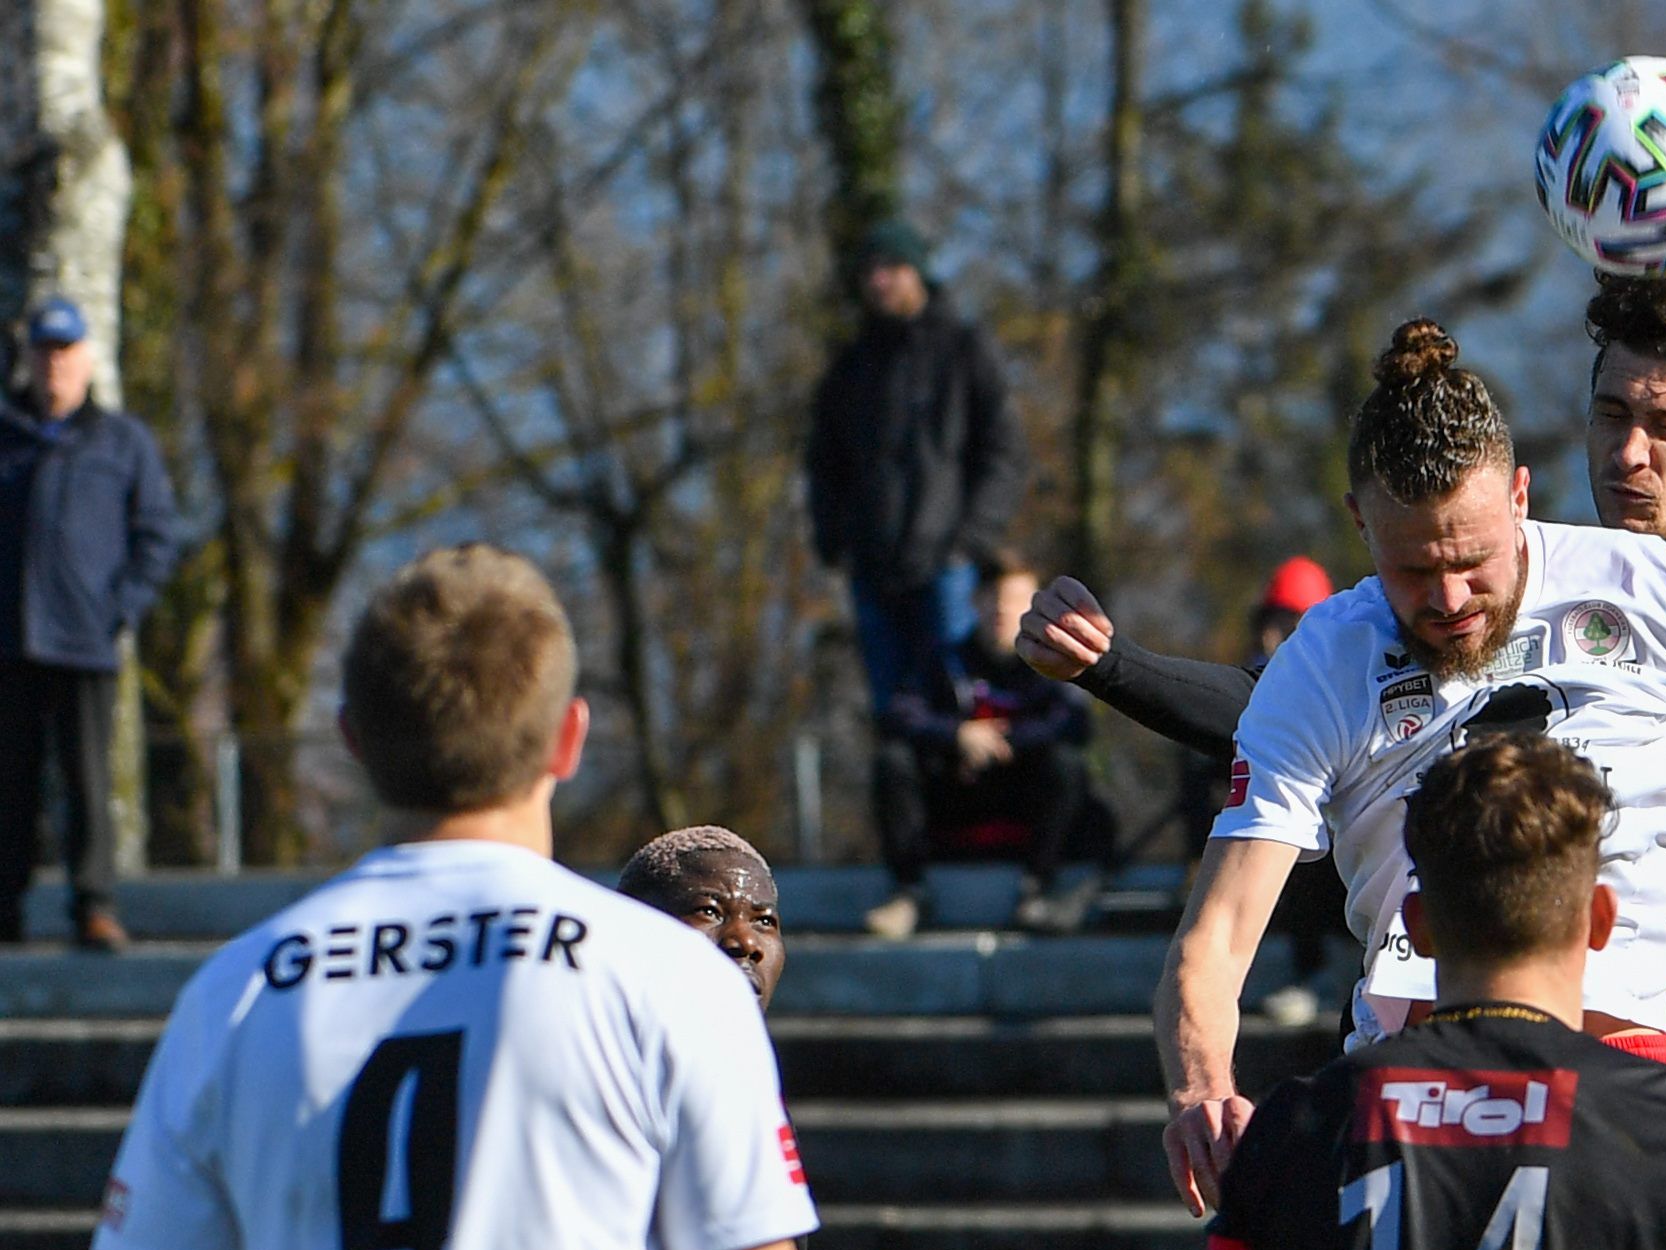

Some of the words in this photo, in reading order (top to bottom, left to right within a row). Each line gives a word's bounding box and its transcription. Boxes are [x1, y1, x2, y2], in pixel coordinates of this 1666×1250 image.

[1399, 697, 1431, 710] LIGA
[263, 908, 589, 991] GERSTER
[1381, 1080, 1549, 1137] Tirol
